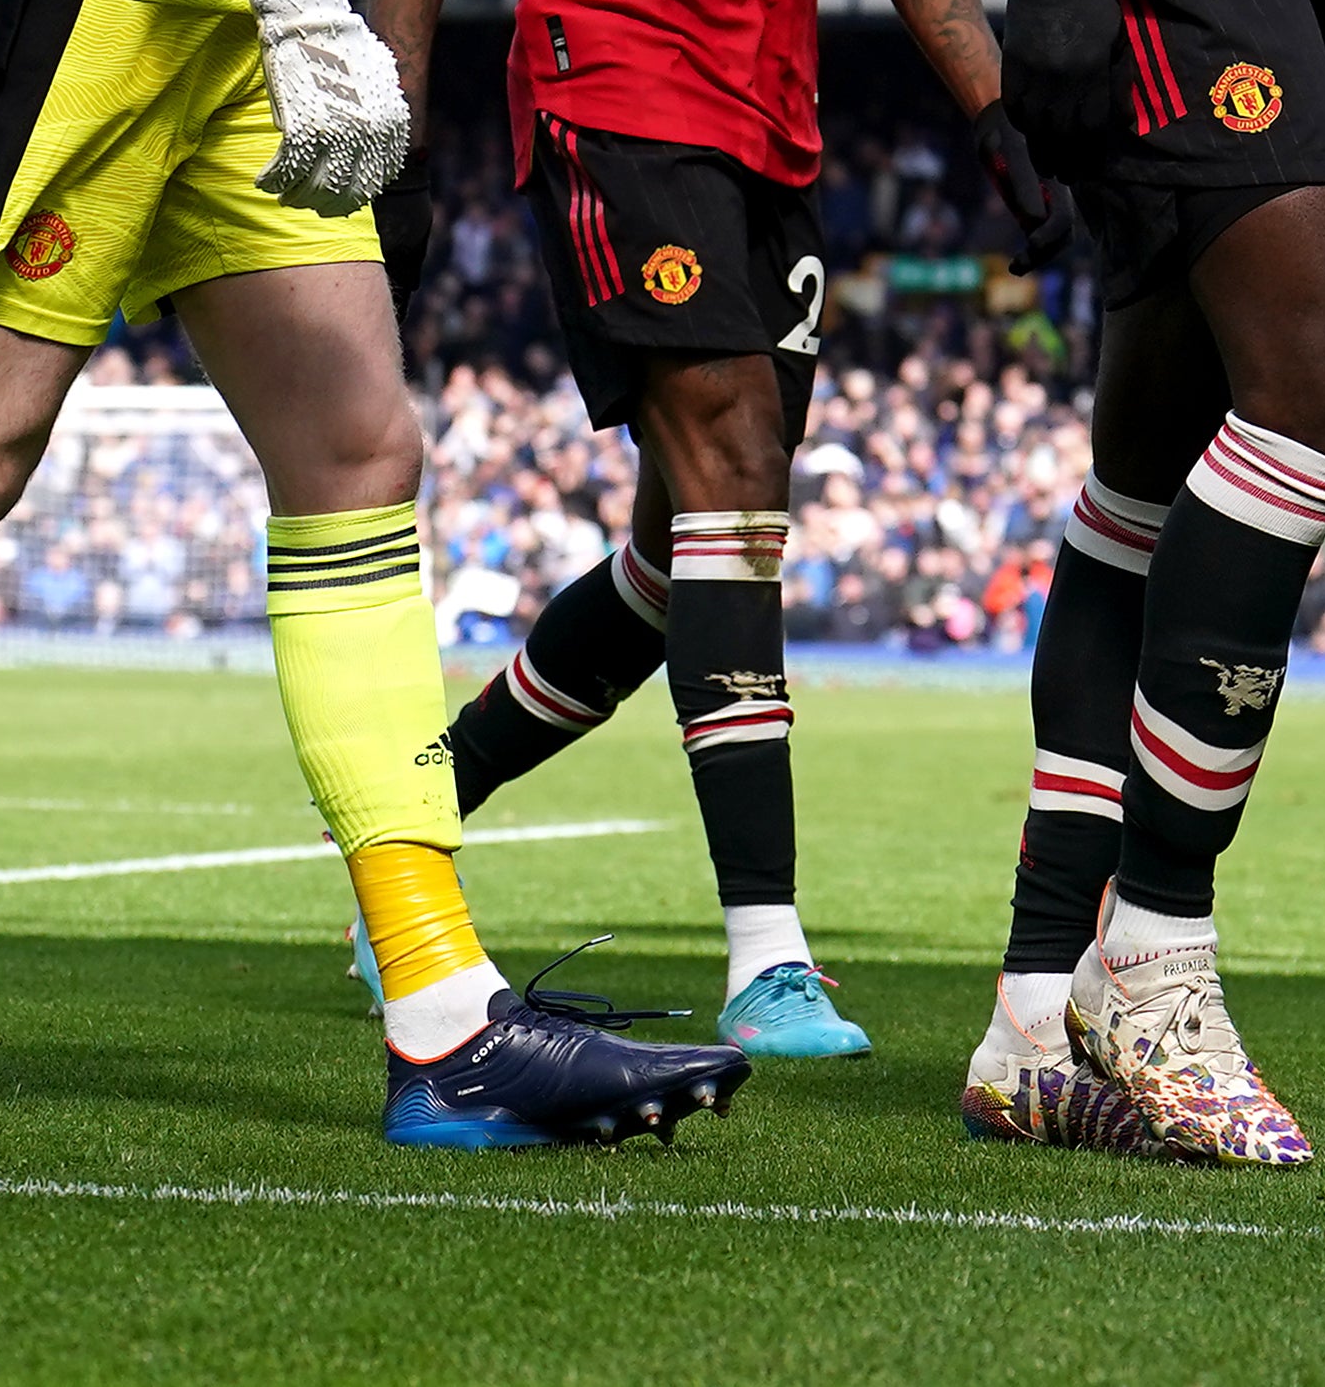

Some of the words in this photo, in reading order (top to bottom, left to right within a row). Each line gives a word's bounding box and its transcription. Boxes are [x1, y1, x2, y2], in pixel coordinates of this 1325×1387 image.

[1216, 67, 1270, 99] MANCHESTER
[1237, 109, 1275, 129] UNITED
[1164, 958, 1210, 977] PREDATOR
[471, 1035, 503, 1063] COPA
